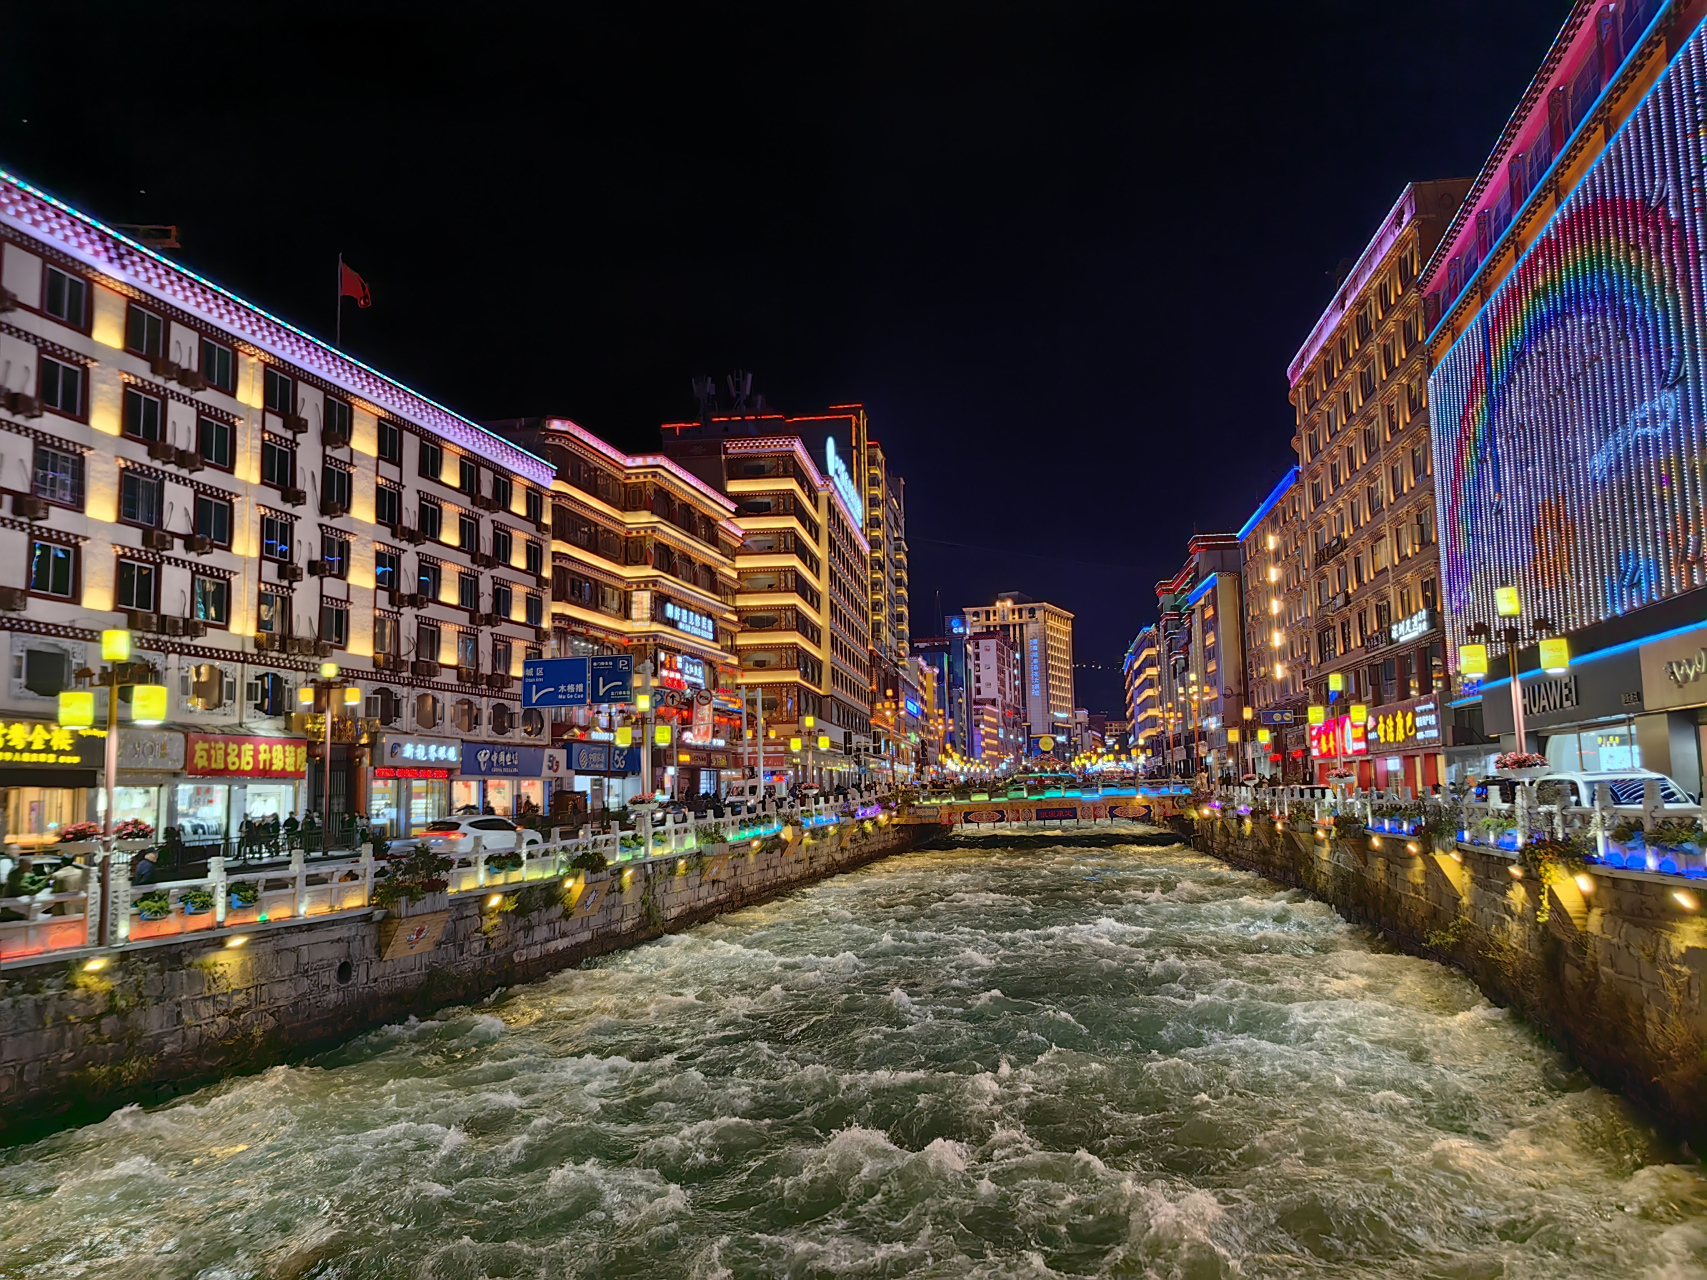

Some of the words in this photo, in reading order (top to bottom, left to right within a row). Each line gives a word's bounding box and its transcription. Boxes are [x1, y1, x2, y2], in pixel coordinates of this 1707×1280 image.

[619, 660, 628, 669] P
[525, 667, 544, 677] 城区
[558, 683, 584, 693] 木格措
[193, 740, 254, 771] 友谊名店
[491, 750, 519, 766] 中国电信
[613, 750, 626, 769] 5G
[547, 754, 560, 773] 5G
[1040, 810, 1073, 818] 浪漫康定
